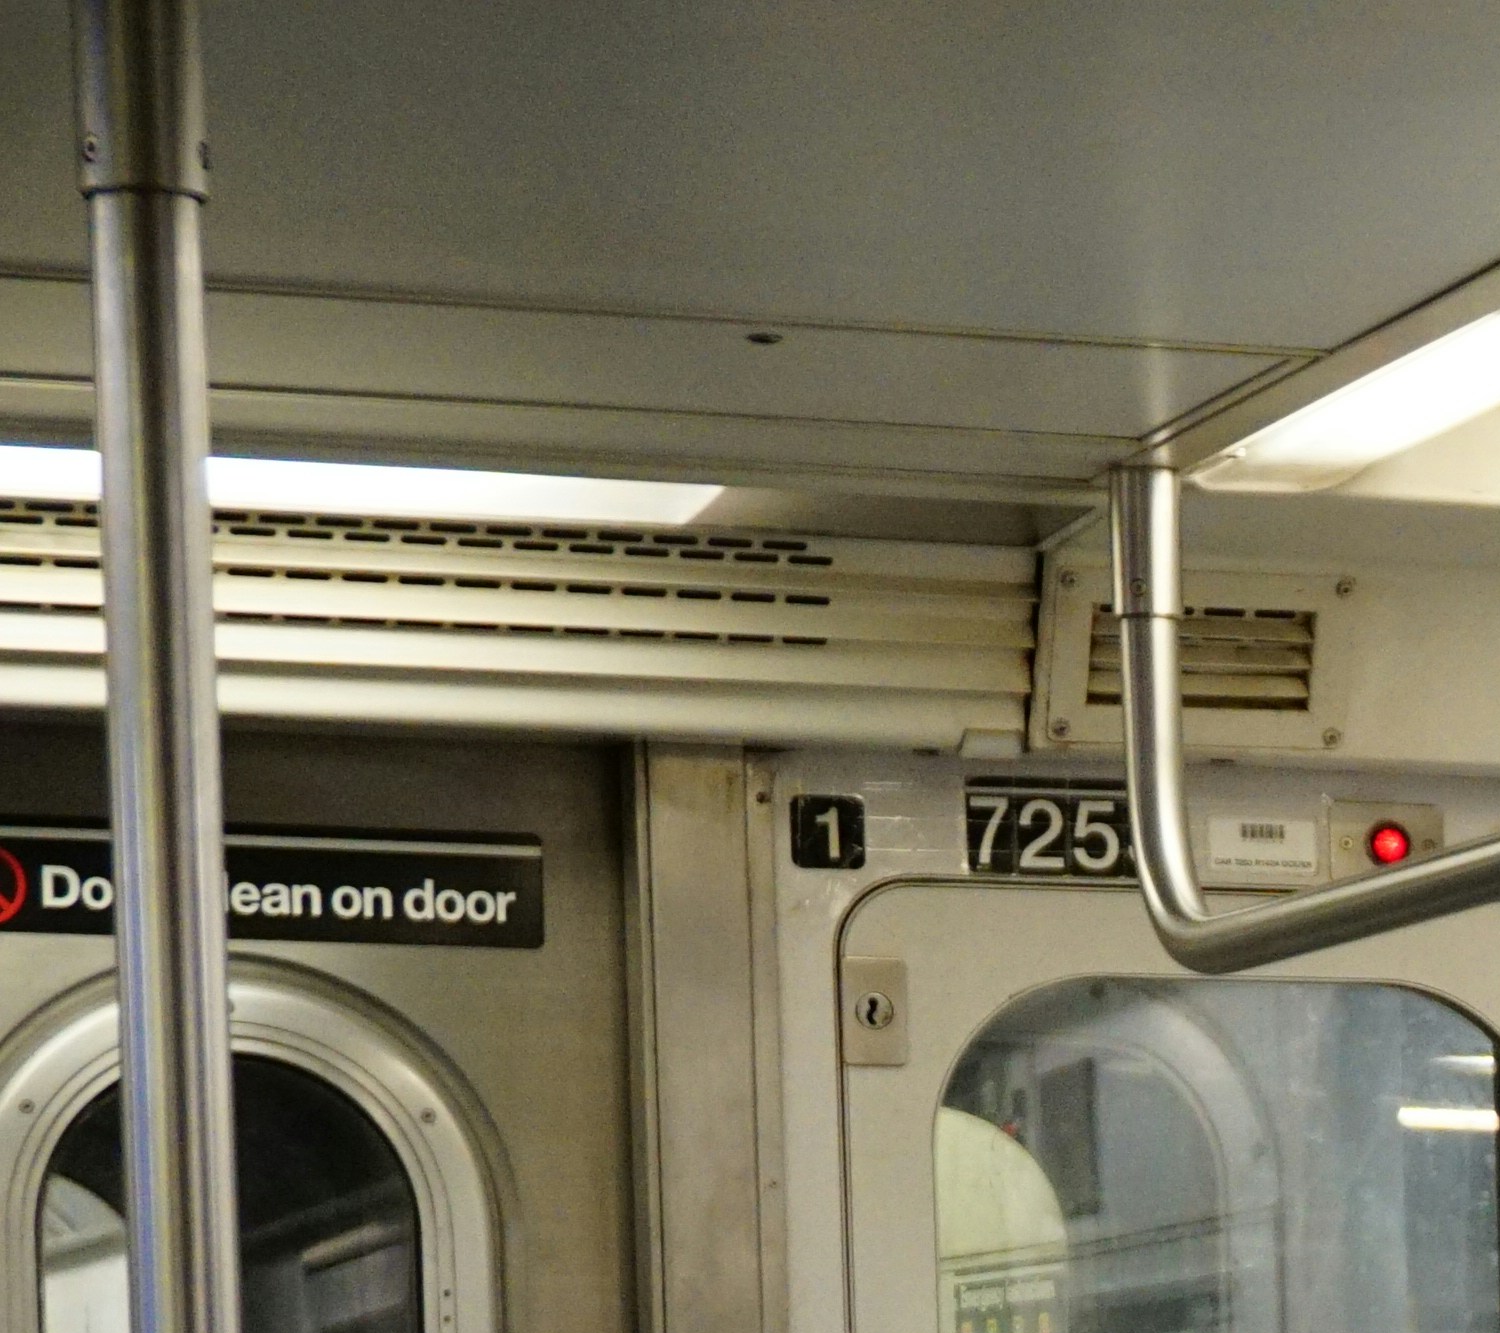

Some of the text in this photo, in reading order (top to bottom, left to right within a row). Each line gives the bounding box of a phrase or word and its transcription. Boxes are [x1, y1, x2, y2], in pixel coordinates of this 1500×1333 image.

[814, 805, 844, 859] 1
[969, 795, 1137, 870] 725
[41, 863, 114, 911] Do
[331, 882, 394, 923] on
[403, 876, 518, 926] door
